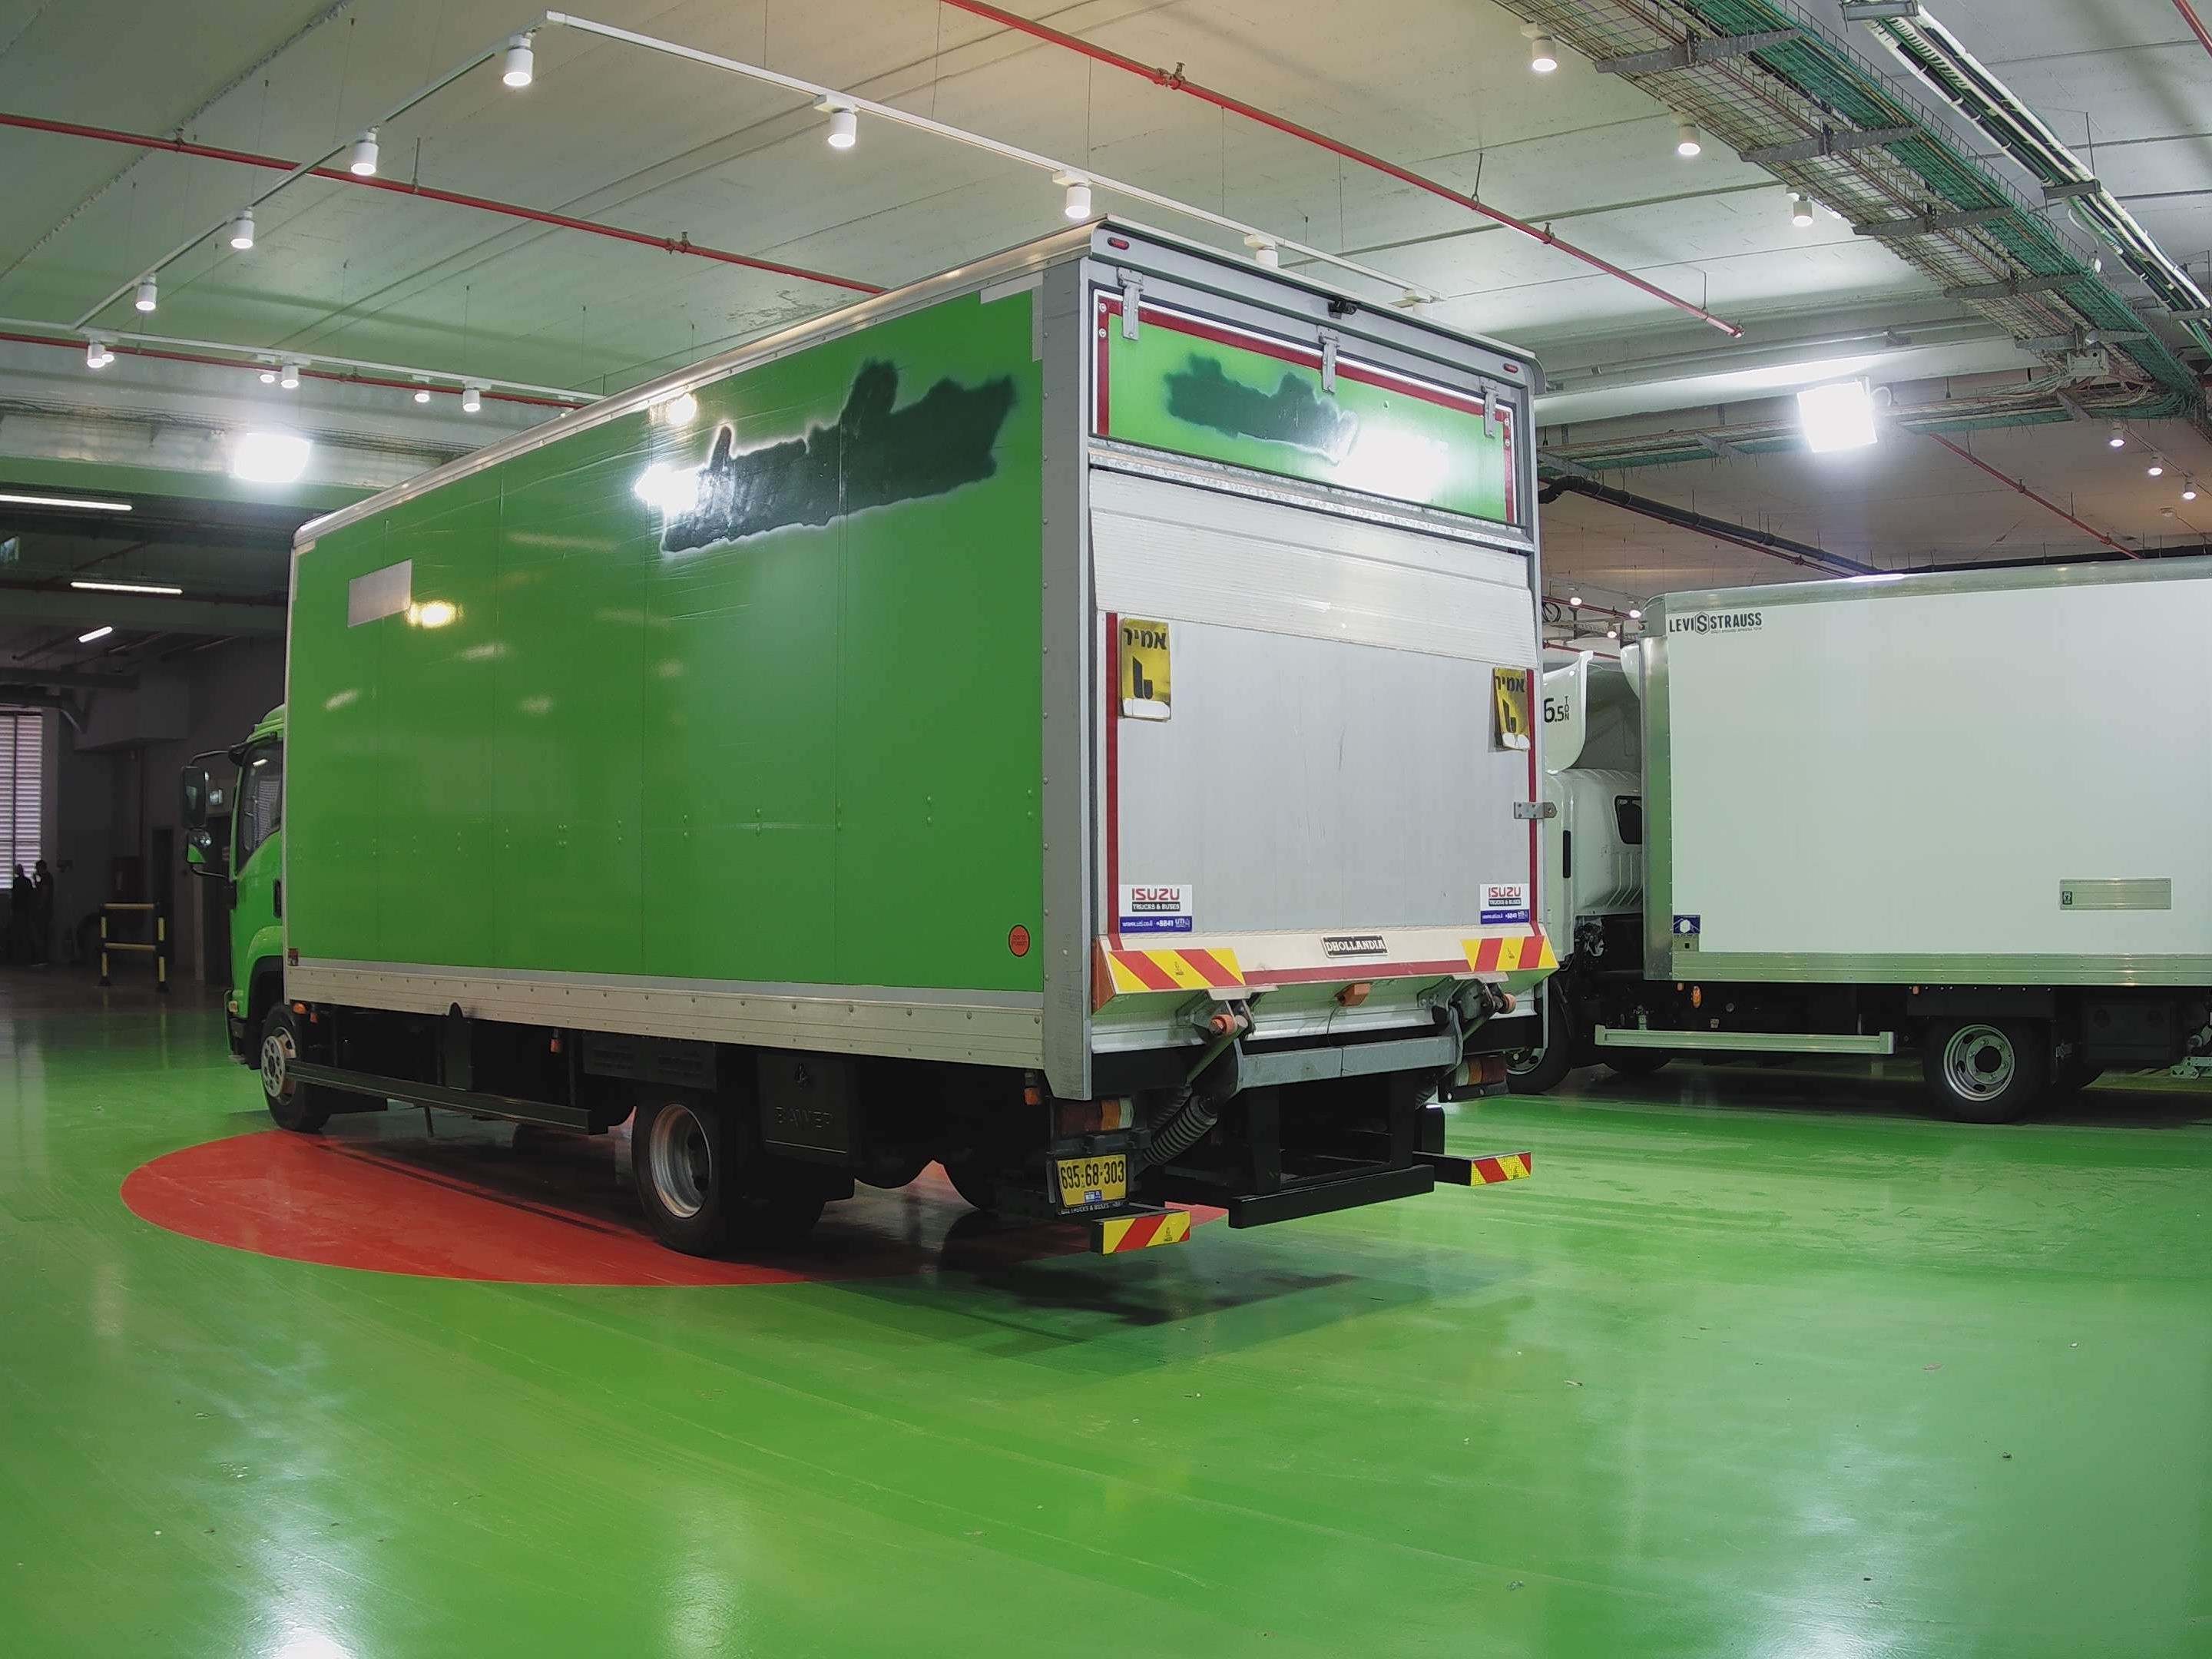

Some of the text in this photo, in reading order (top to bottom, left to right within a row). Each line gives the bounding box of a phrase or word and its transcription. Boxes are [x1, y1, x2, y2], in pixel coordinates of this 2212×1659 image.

[1710, 612, 1762, 630] STRAUSS
[1123, 628, 1167, 651] אמיר
[1495, 676, 1525, 692] אמיר
[1544, 697, 1564, 723] 6.5
[1132, 888, 1180, 901] ISUZU
[1488, 886, 1521, 898] ISUZU
[1325, 939, 1386, 952] DHOLLANDIA
